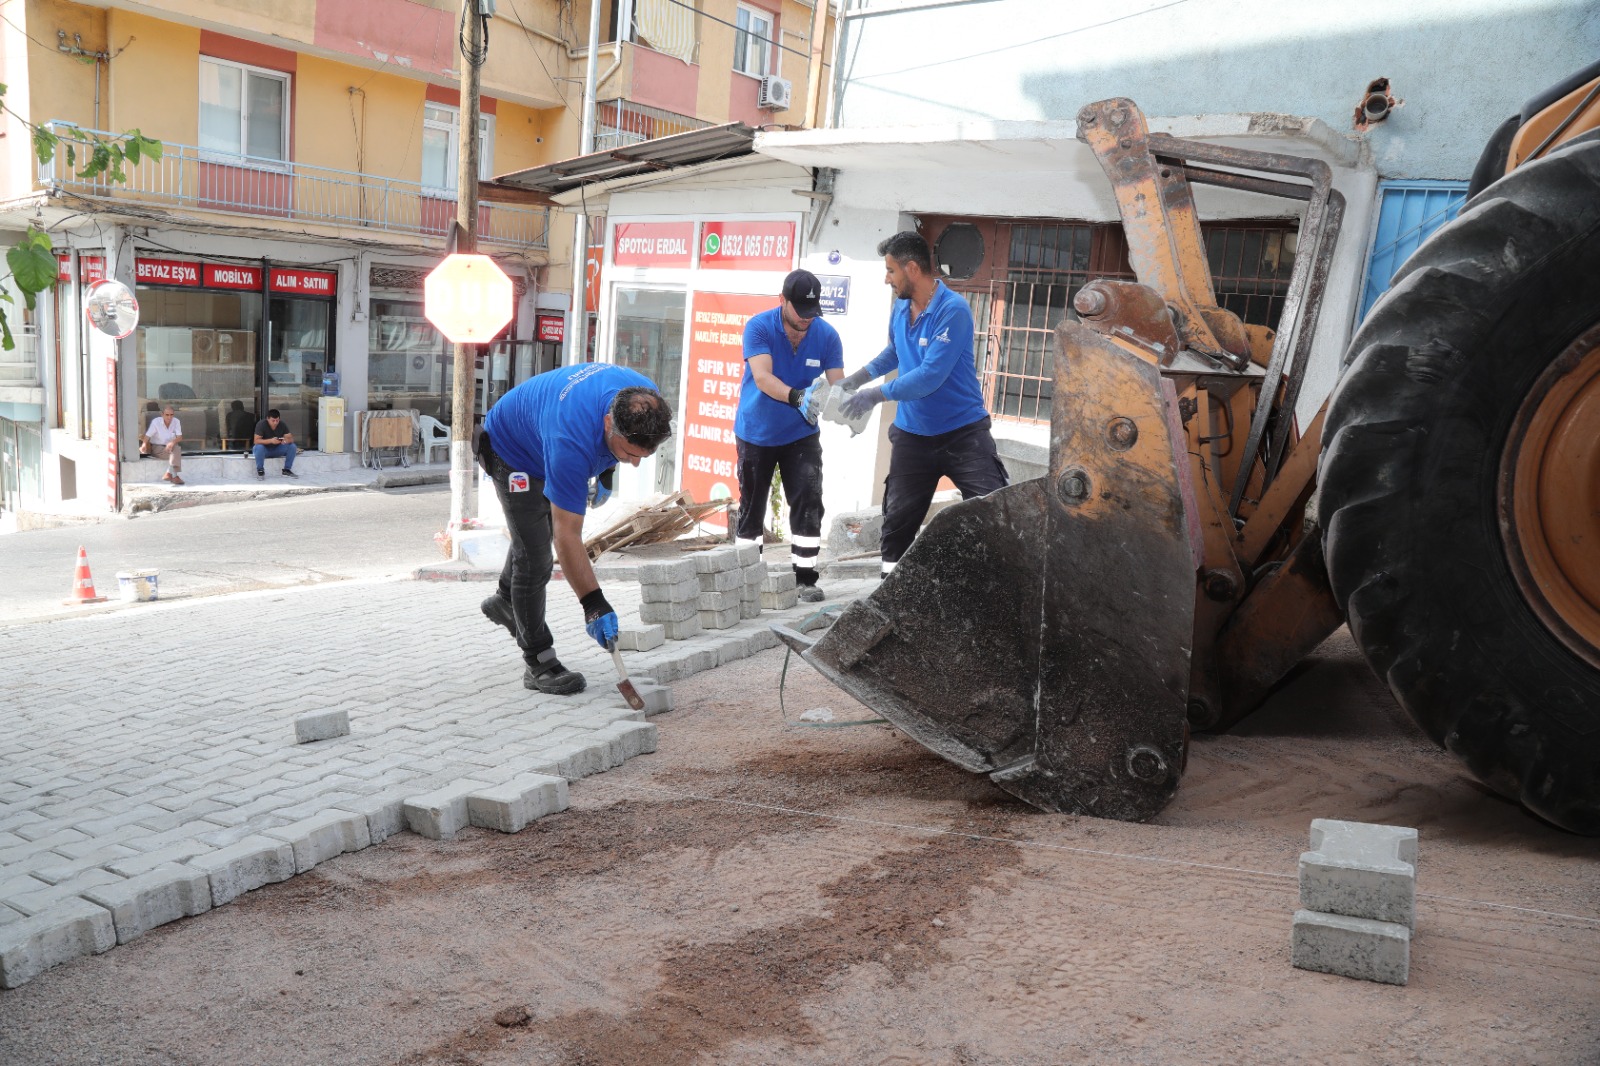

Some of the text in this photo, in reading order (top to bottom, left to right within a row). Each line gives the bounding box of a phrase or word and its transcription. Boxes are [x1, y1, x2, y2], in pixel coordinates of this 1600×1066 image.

[618, 237, 688, 255] SPOTCU ERDAL
[721, 234, 788, 258] 0532 065 67 83
[138, 263, 196, 282] BEYAZ EŞYA
[214, 268, 253, 285] MOBİLYA
[276, 274, 297, 288] ALIM
[303, 276, 328, 290] SATIM
[697, 358, 724, 376] SIFIR
[726, 361, 741, 378] VE
[703, 379, 718, 395] EV
[687, 423, 722, 443] ALINIR
[687, 453, 712, 474] 0532
[713, 458, 732, 478] 065
